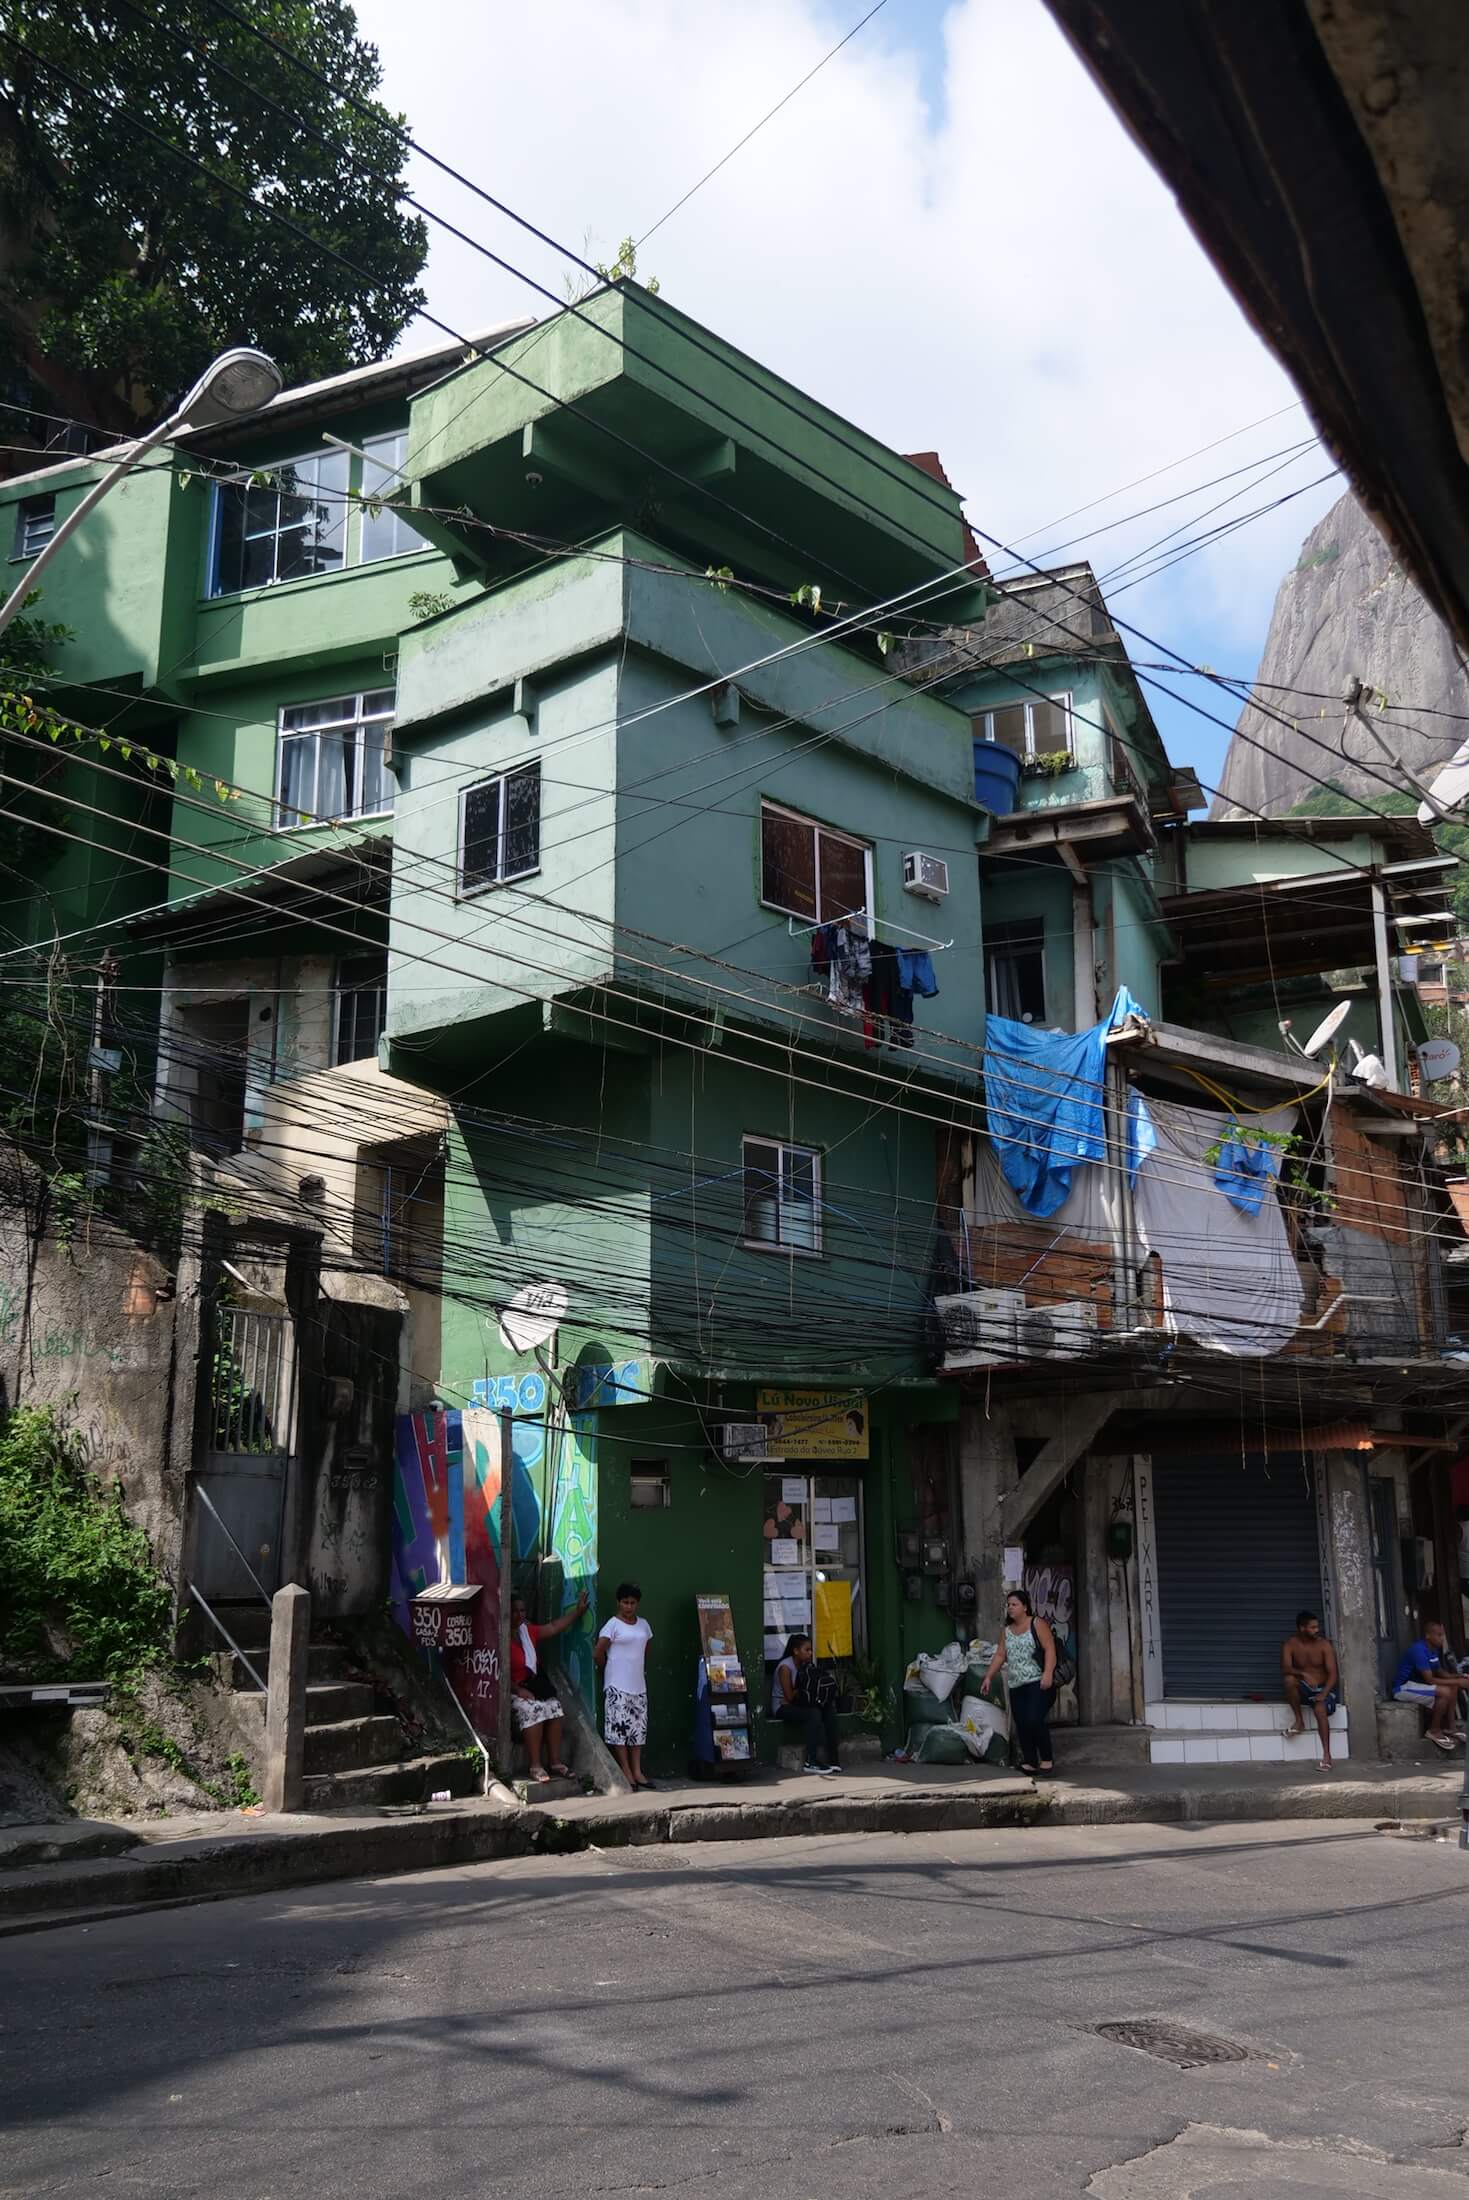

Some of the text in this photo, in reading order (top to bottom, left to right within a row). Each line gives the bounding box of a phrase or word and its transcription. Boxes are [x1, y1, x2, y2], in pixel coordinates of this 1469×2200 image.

[468, 1373, 545, 1412] 350
[784, 1393, 820, 1406] Novo
[1140, 1476, 1155, 1658] PEIXARIA
[1316, 1469, 1333, 1638] PEIXARI
[413, 1606, 441, 1629] 350
[445, 1628, 467, 1647] 350
